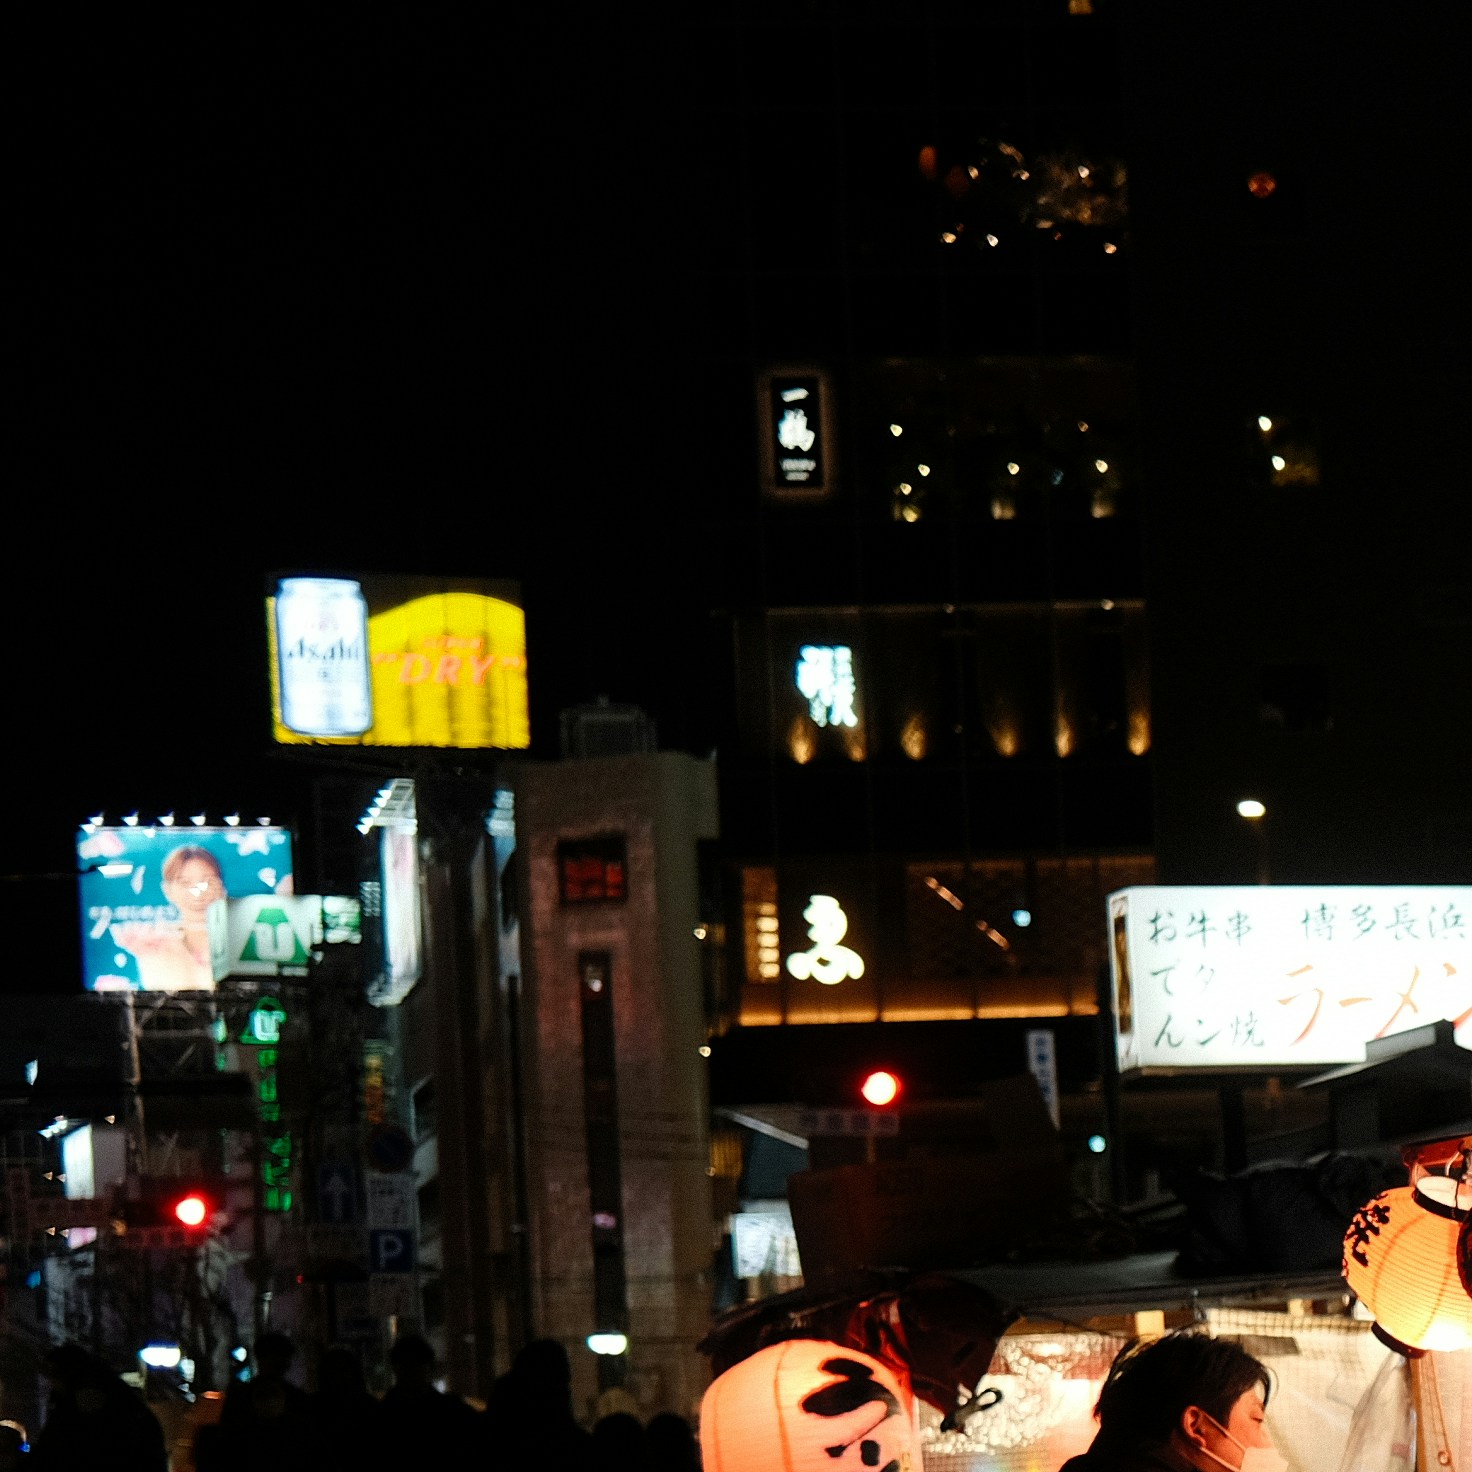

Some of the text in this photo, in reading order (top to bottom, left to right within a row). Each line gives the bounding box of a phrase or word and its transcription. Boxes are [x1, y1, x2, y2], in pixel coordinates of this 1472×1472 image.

[1185, 909, 1222, 1047] 牛タン
[1225, 909, 1265, 1048] 串焼
[1300, 902, 1469, 942] 博多長浜
